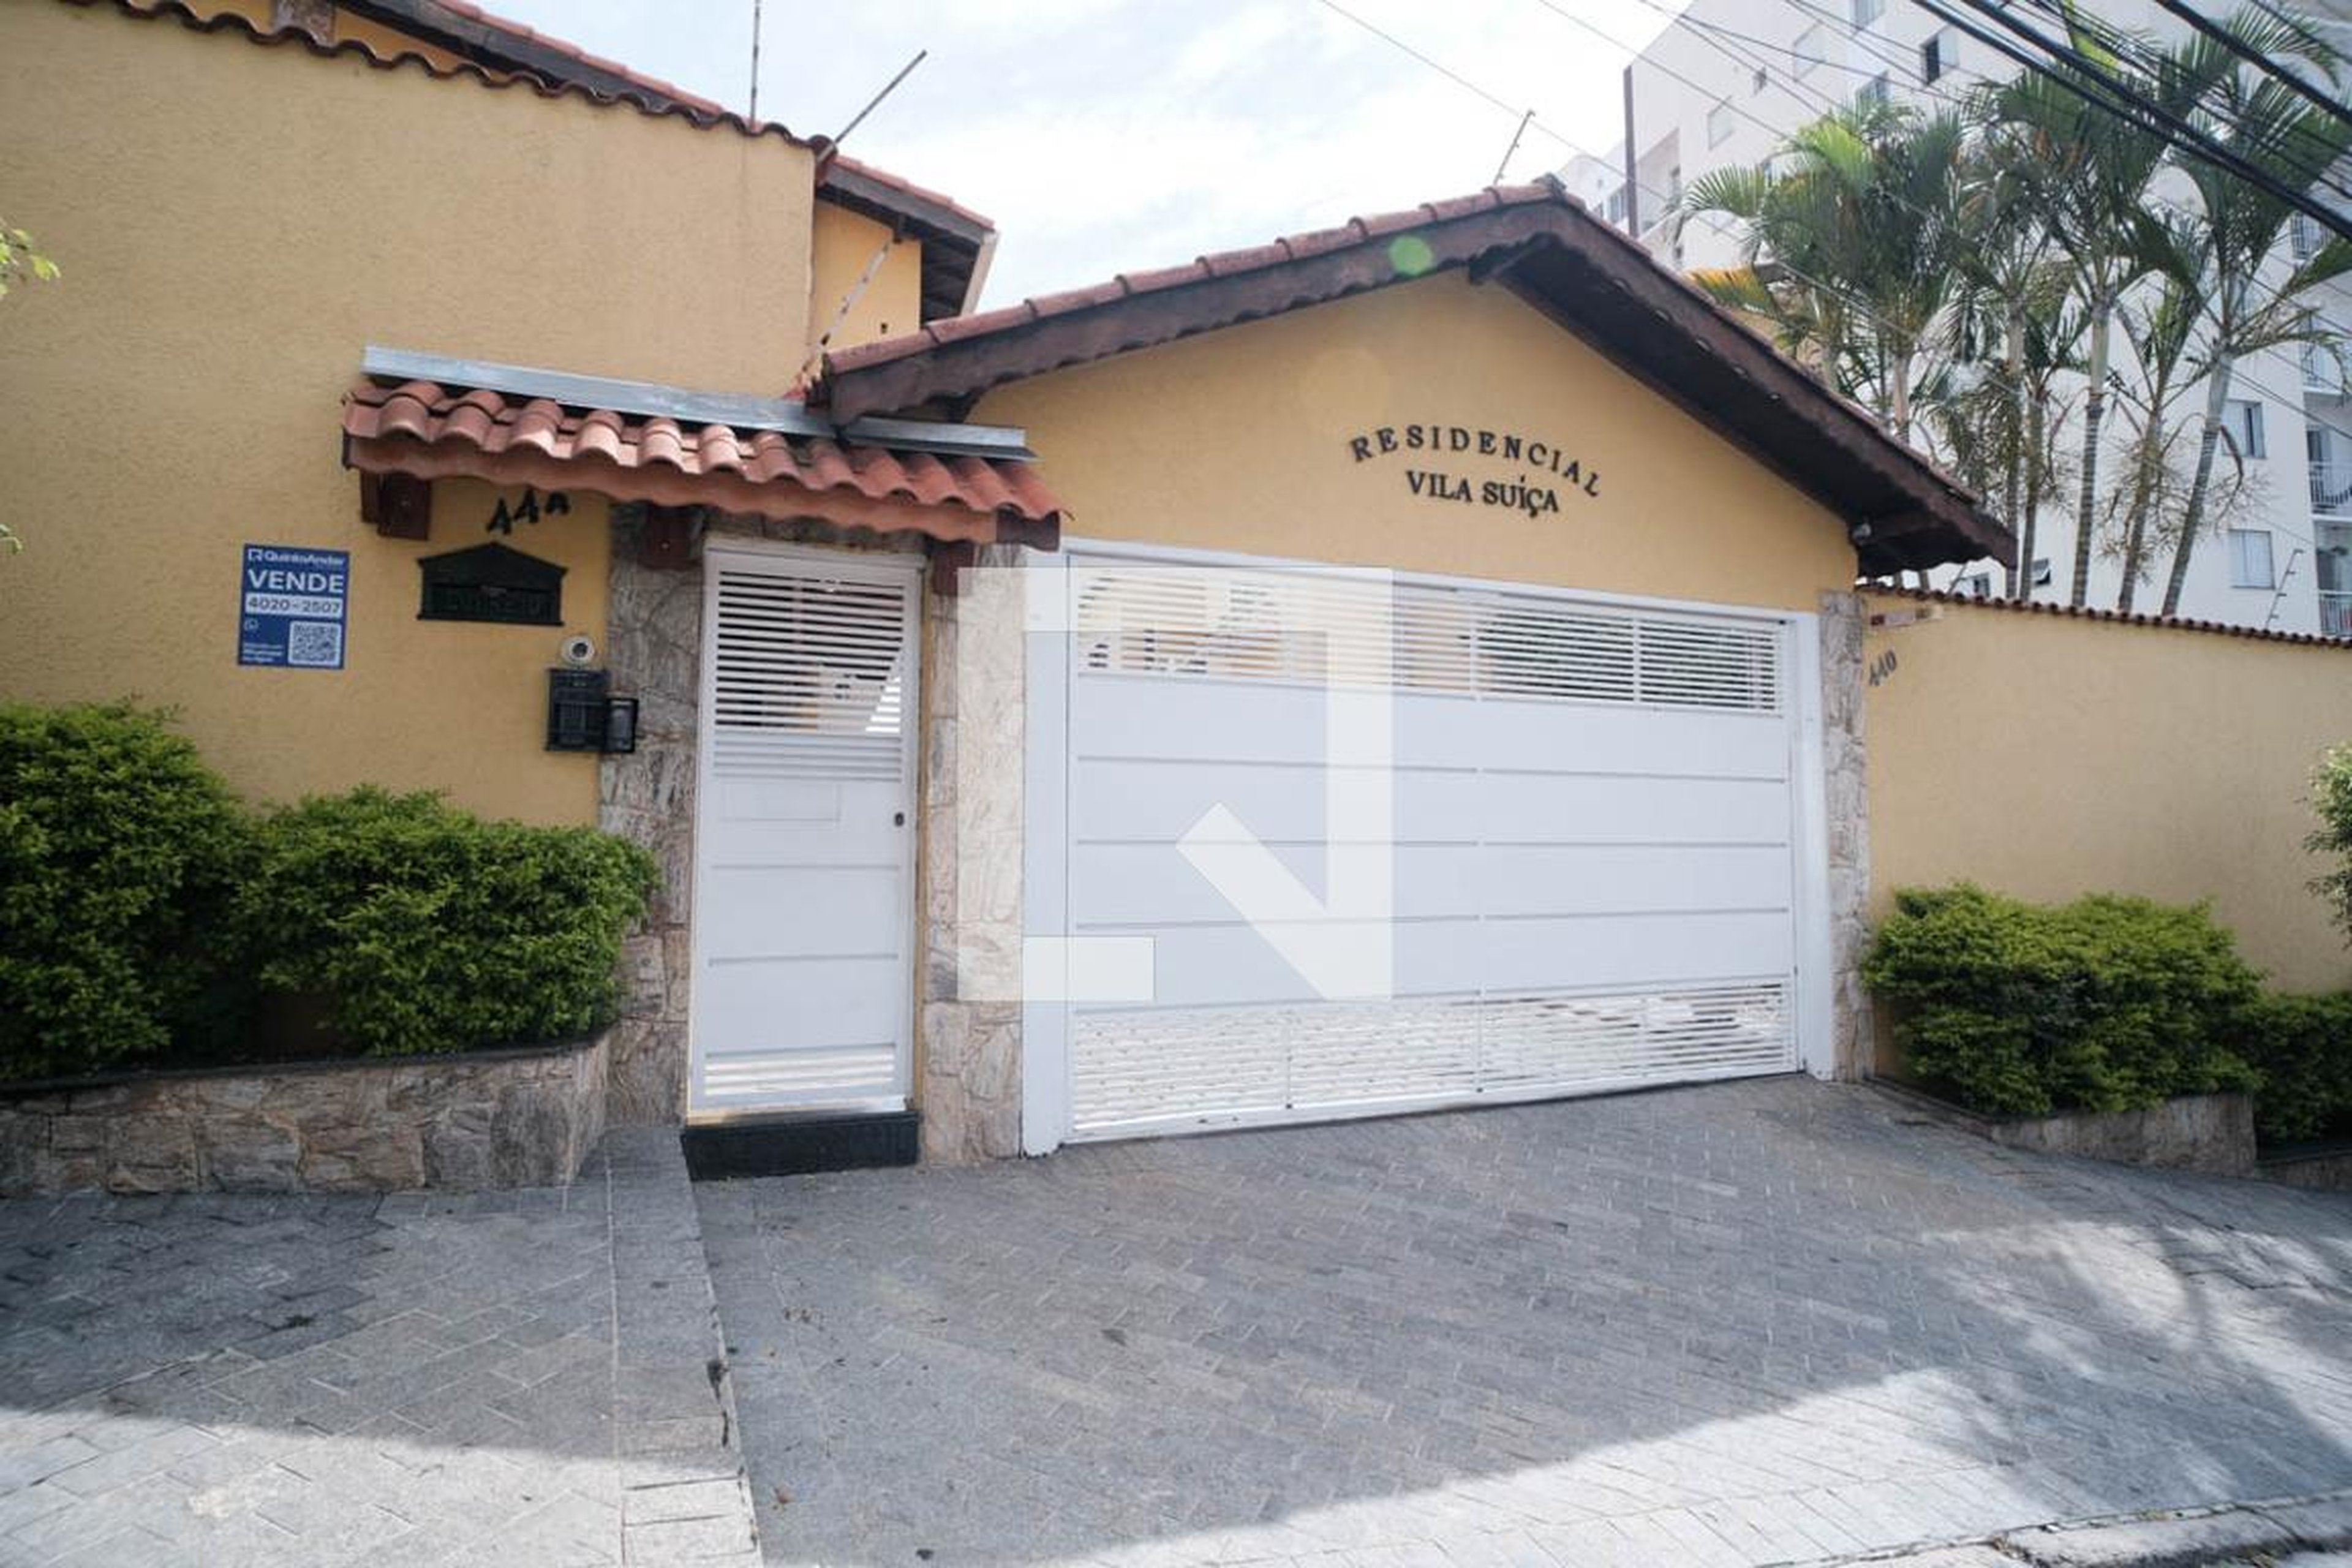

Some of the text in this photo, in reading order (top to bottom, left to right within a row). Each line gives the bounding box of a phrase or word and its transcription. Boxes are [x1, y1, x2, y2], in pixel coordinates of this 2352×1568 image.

[1349, 424, 1602, 497] RESIDENCIAL
[1406, 470, 1559, 518] VILA SUÍÇA
[247, 569, 344, 594] VENDE
